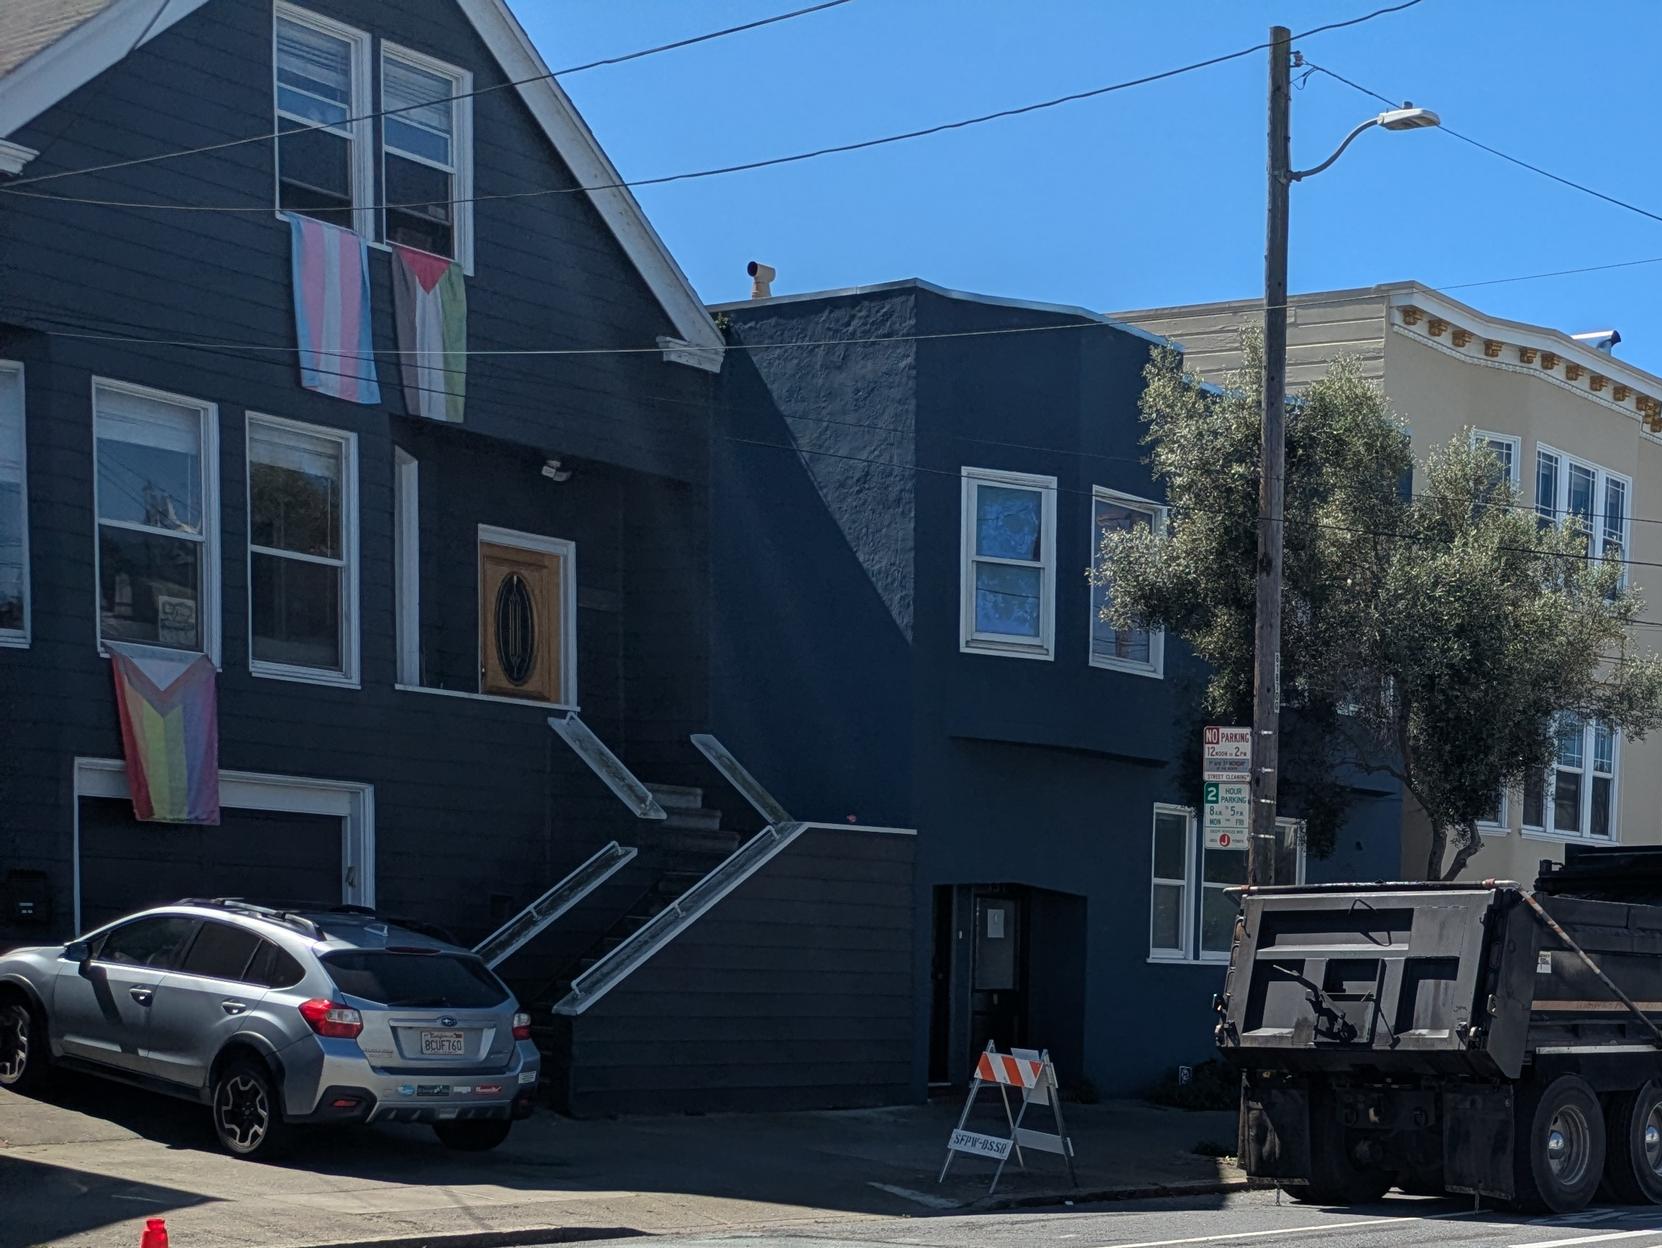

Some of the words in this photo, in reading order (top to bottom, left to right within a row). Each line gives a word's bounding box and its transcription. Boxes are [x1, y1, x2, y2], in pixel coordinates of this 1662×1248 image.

[1206, 729, 1218, 743] NO
[1221, 732, 1249, 743] PARKING
[1208, 787, 1217, 801] 2
[1221, 835, 1228, 845] J
[425, 1040, 462, 1051] 8CUF760
